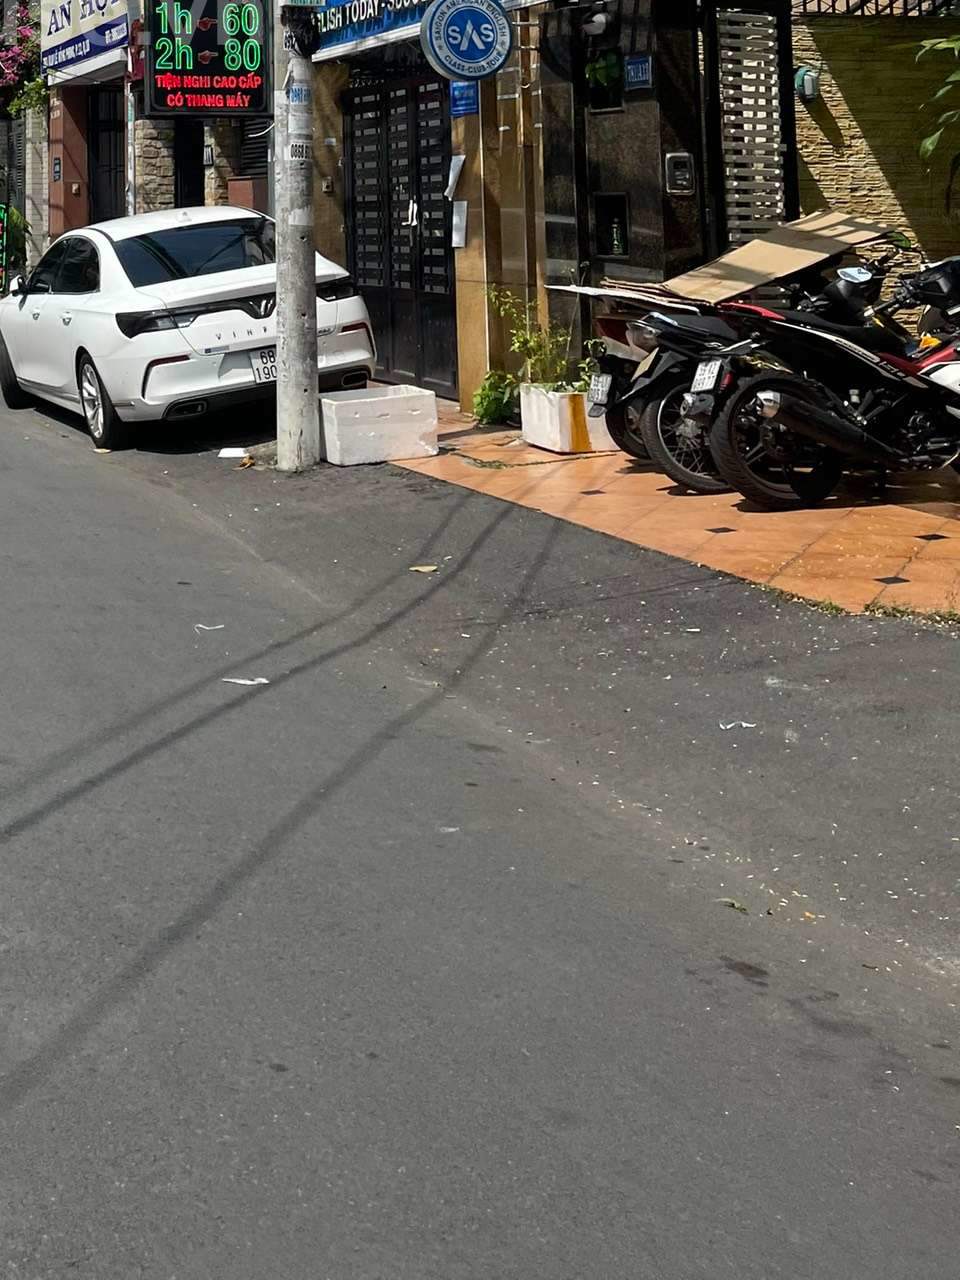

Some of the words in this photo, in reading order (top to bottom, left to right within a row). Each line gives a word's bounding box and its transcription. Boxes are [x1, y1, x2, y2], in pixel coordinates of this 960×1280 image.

[47, 0, 71, 36] AN
[155, 2, 192, 34] 1h
[223, 3, 259, 36] 60
[485, 2, 507, 37] ENGLISH
[447, 19, 494, 51] SAS
[155, 37, 193, 70] 2h
[224, 38, 261, 71] 80
[155, 72, 181, 90] TIỆN
[183, 75, 211, 89] NGHI
[213, 75, 237, 89] CAO
[238, 72, 262, 89] CẤP
[167, 91, 184, 107] CÓ
[186, 94, 223, 107] THANG
[226, 92, 251, 107] MÁY
[260, 350, 277, 365] 68
[256, 366, 278, 382] 190
